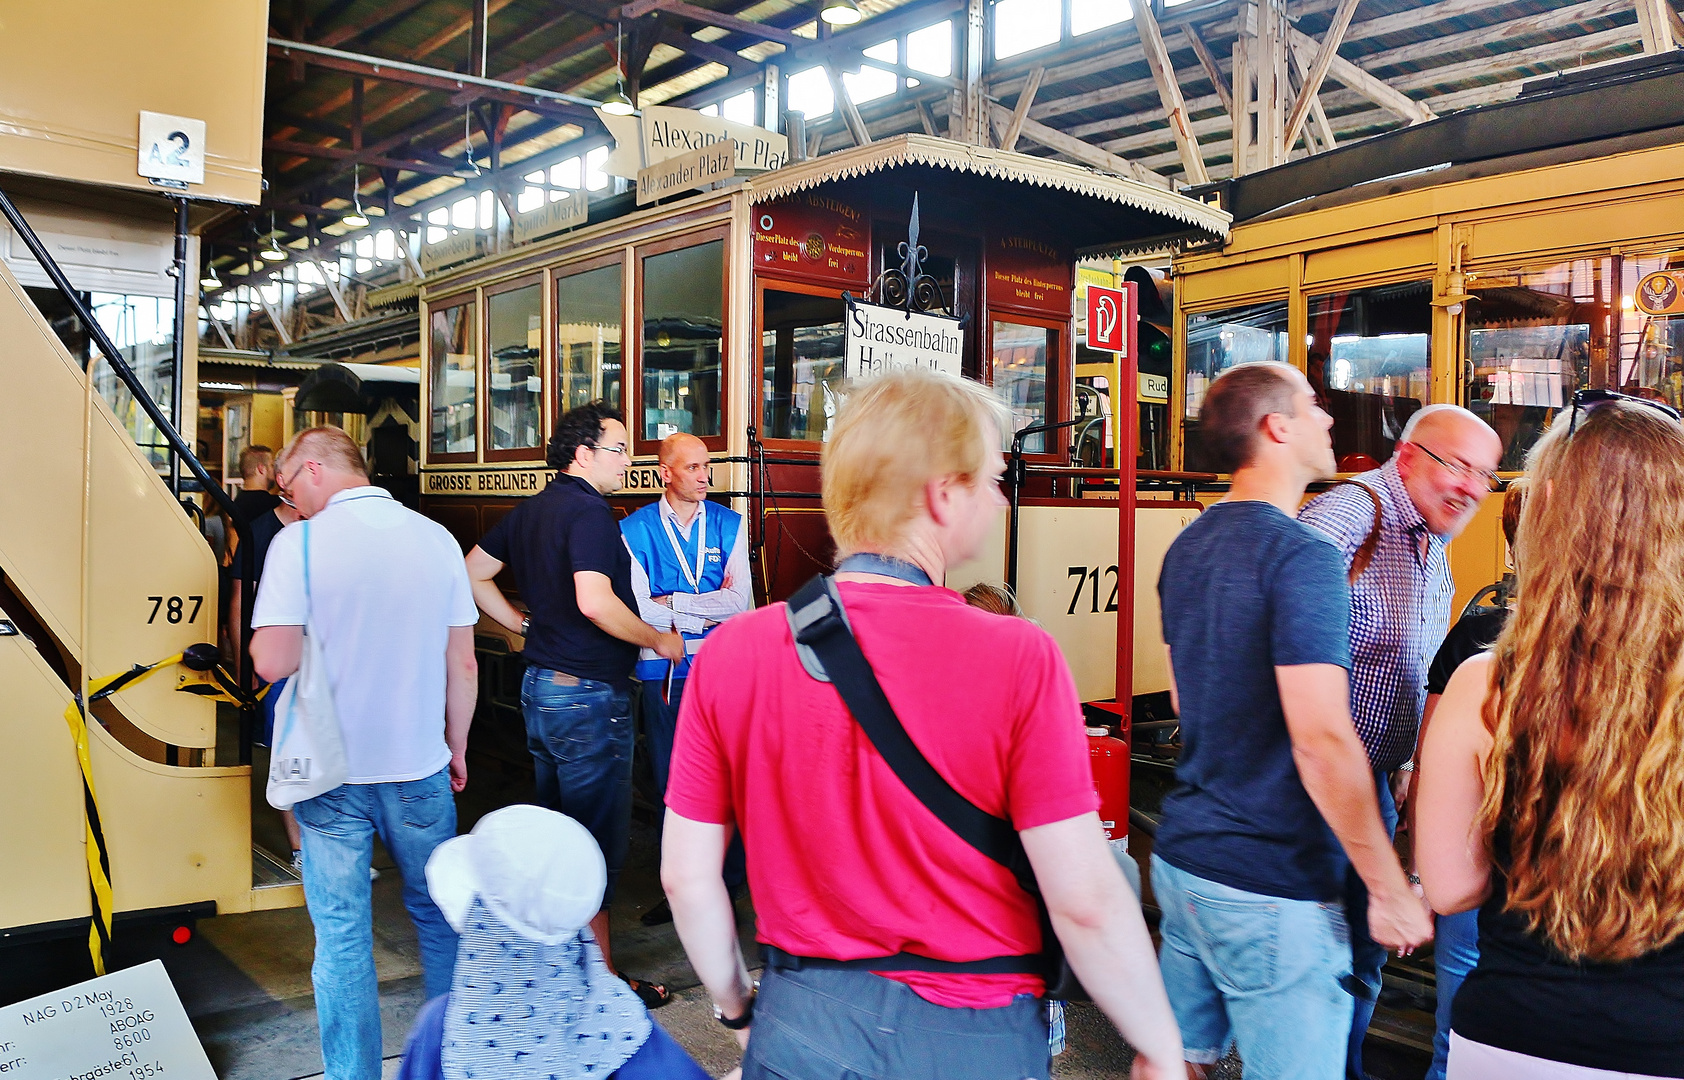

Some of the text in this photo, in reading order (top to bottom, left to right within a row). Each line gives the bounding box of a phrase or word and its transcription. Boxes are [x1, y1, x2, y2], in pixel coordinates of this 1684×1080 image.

[753, 138, 789, 171] Plat
[640, 152, 729, 196] Alexander Platz
[828, 258, 839, 269] frei
[852, 308, 959, 355] Strassenbahn
[428, 474, 472, 491] GROSSE
[478, 473, 538, 491] BERLINER
[1067, 564, 1119, 615] 712
[147, 595, 204, 625] 787
[22, 1005, 57, 1026] NAG
[99, 997, 134, 1019] 1928
[109, 1009, 155, 1035] ABOAG
[113, 1027, 151, 1051] 8600
[129, 1060, 164, 1080] 1954
